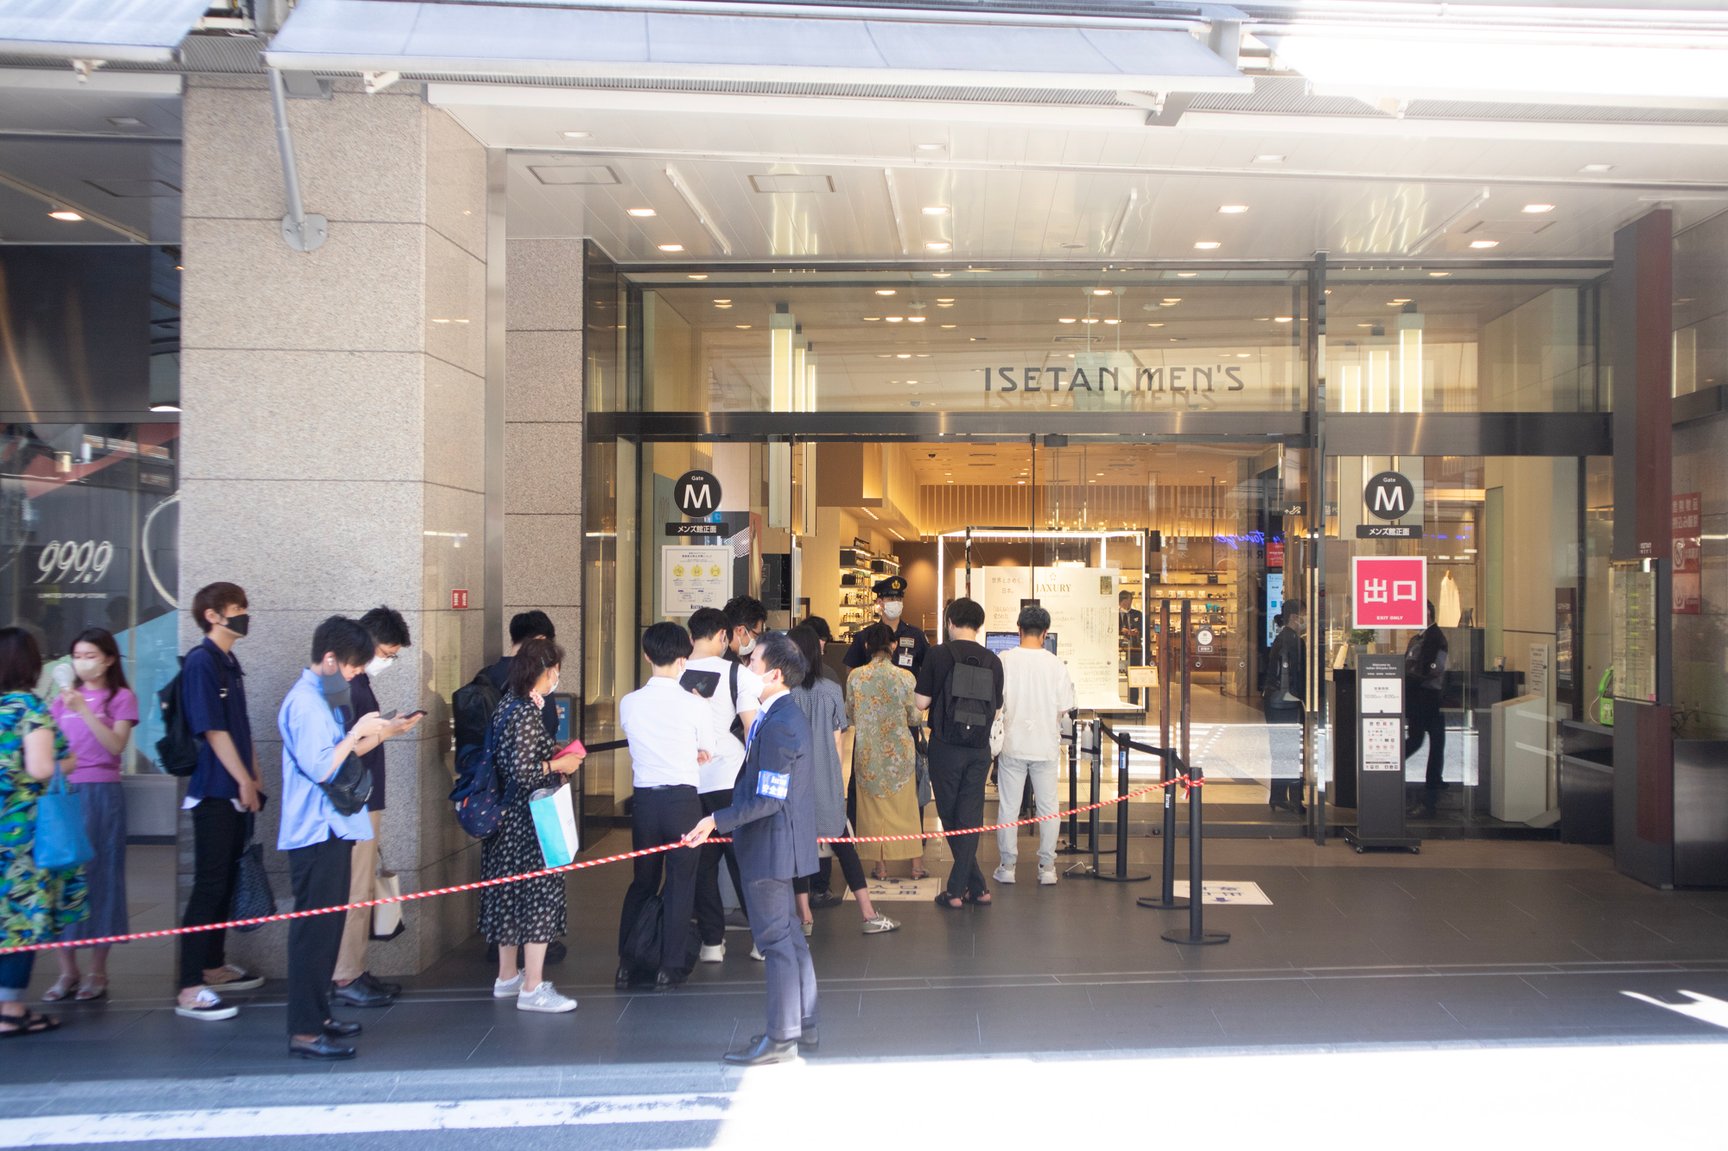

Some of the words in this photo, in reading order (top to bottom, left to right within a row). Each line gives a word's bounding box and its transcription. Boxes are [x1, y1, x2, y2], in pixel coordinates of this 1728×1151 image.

[984, 367, 1119, 392] ISETAN
[1136, 364, 1245, 392] MEN'S
[683, 484, 712, 509] M
[1374, 486, 1405, 511] M
[677, 525, 717, 534] メンズ館正面
[1369, 527, 1410, 536] メンズ館正面
[33, 540, 113, 584] 999.9
[1036, 583, 1071, 593] JAXURY
[1364, 578, 1416, 604] 出口
